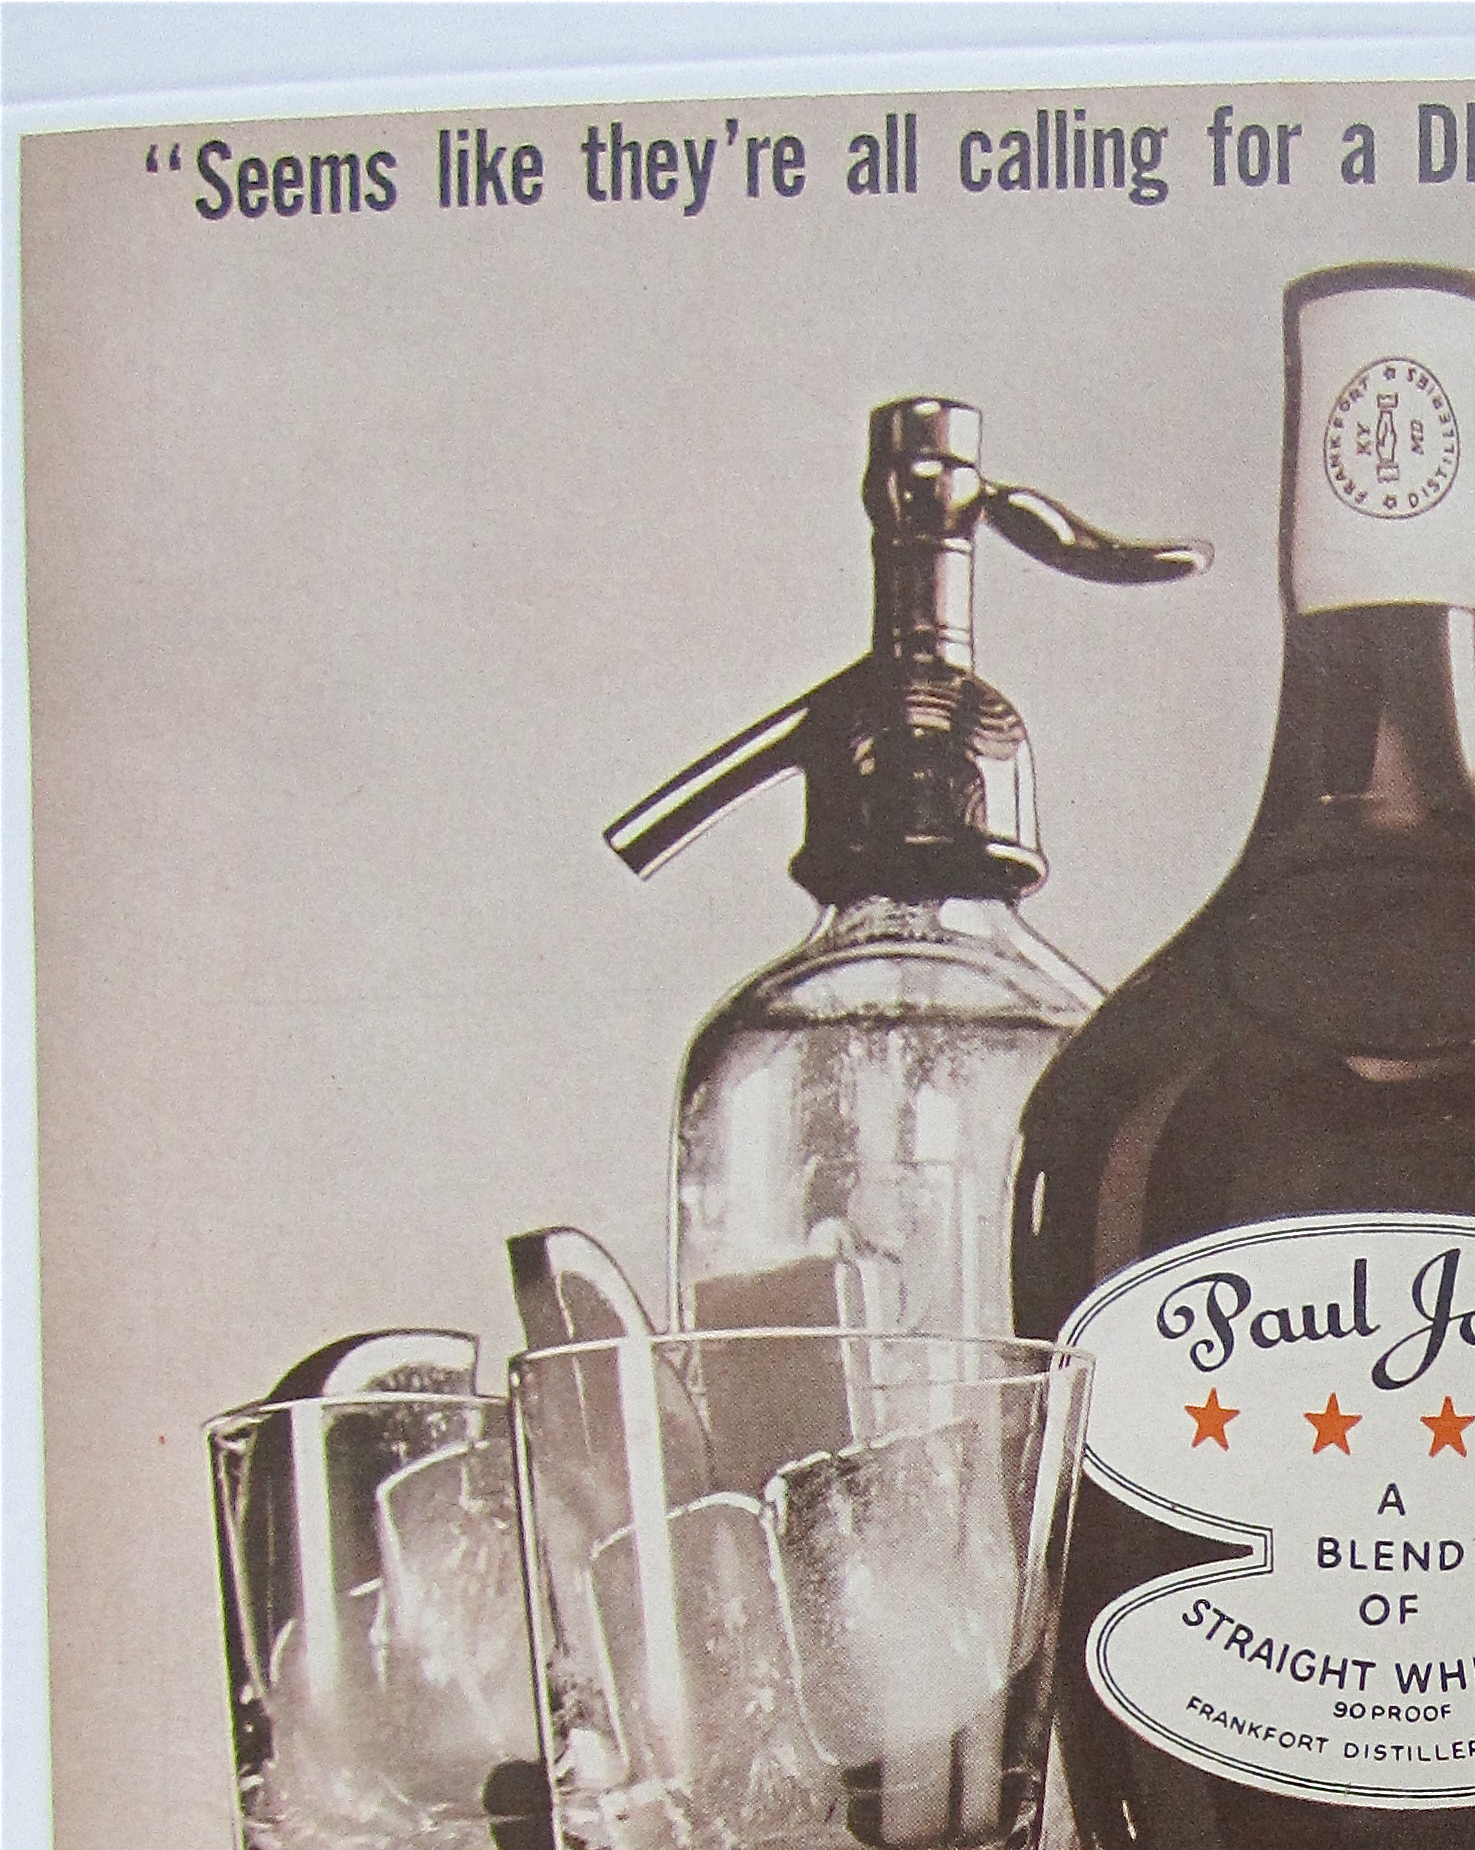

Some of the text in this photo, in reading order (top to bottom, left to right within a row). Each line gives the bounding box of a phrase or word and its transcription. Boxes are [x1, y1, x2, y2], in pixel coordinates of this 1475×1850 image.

[438, 128, 544, 208] like
[580, 118, 806, 217] they’re
[846, 112, 917, 196] all
[959, 108, 1169, 206] calling
[1206, 105, 1303, 187] for
[1340, 123, 1376, 185] a
[1331, 375, 1369, 504] FRANKFORT
[1407, 367, 1455, 508] DISTILLERIES
[1155, 1257, 1381, 1373] Paul
[1377, 1482, 1406, 1517] A
[1317, 1536, 1465, 1573] BLEND
[1181, 1598, 1377, 1692] STRAIGHT
[1358, 1593, 1419, 1626] OF
[1185, 1695, 1330, 1755] FRANKFORT
